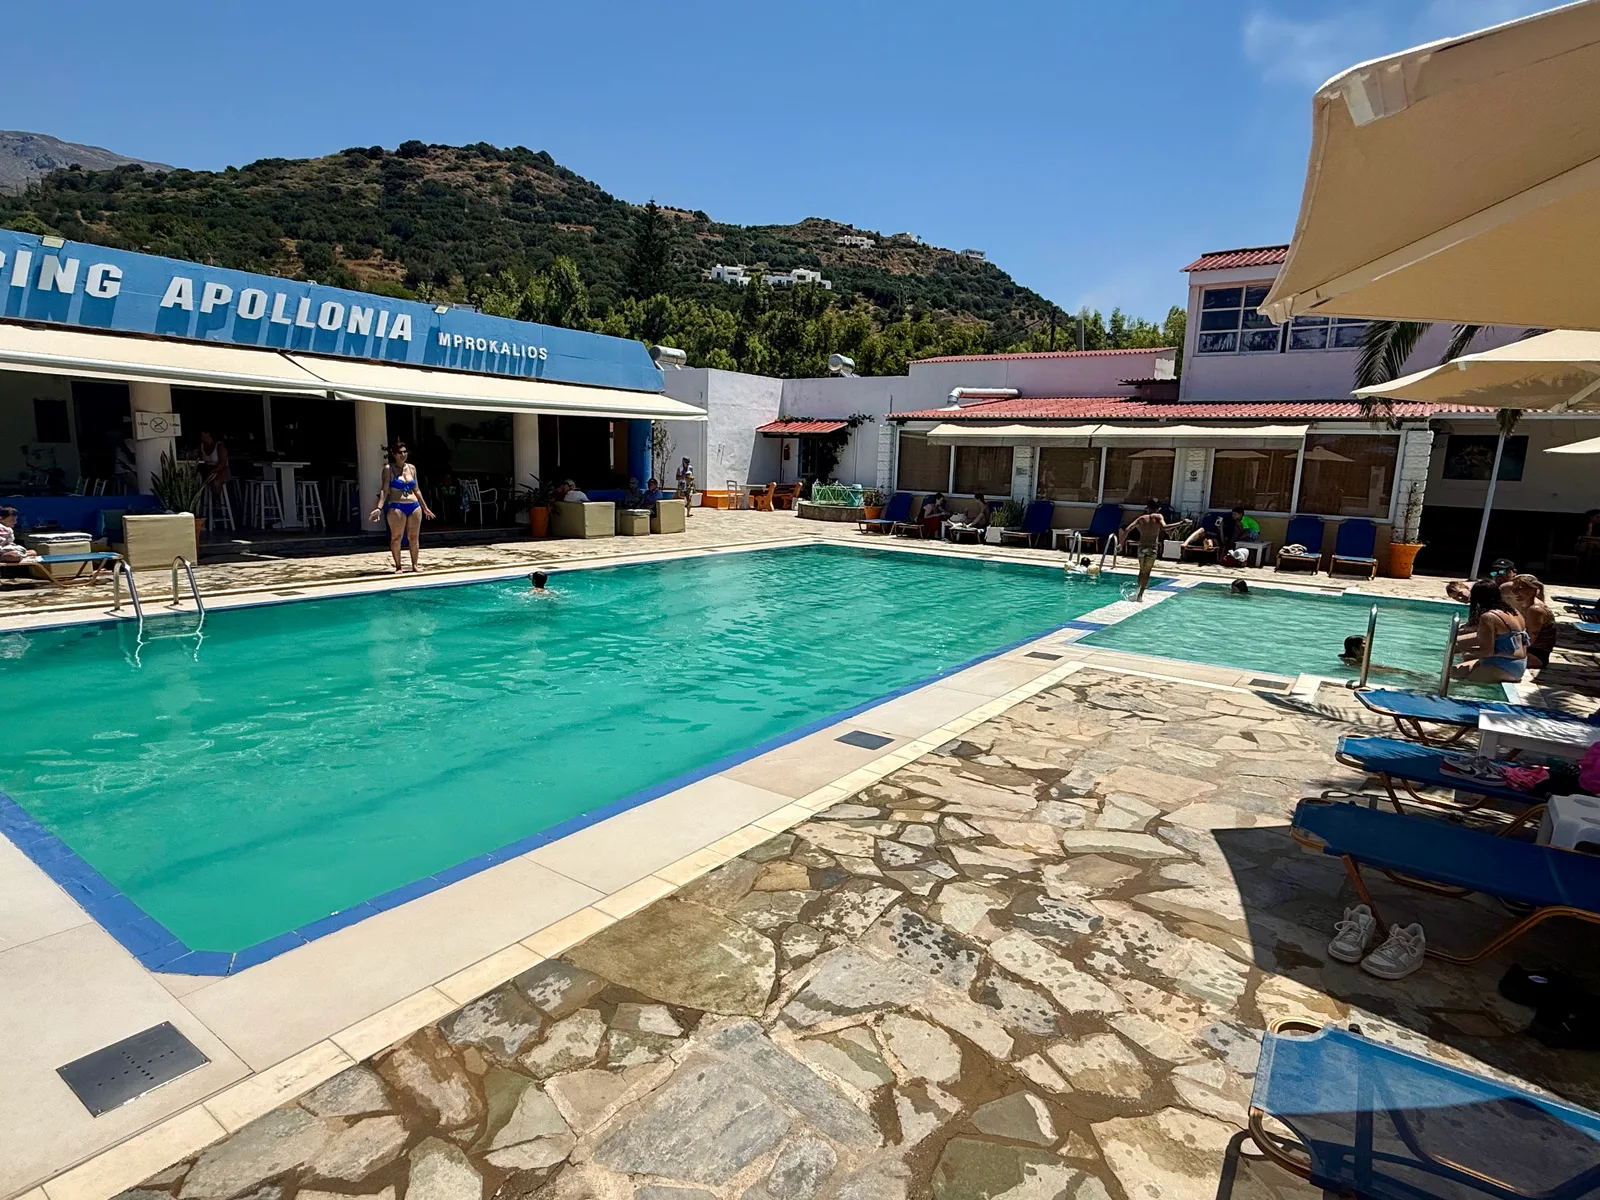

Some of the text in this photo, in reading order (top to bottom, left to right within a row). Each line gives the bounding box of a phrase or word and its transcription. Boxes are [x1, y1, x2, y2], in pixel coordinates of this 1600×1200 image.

[0, 250, 548, 361] ING APOLLONIA MPROKALIOS
